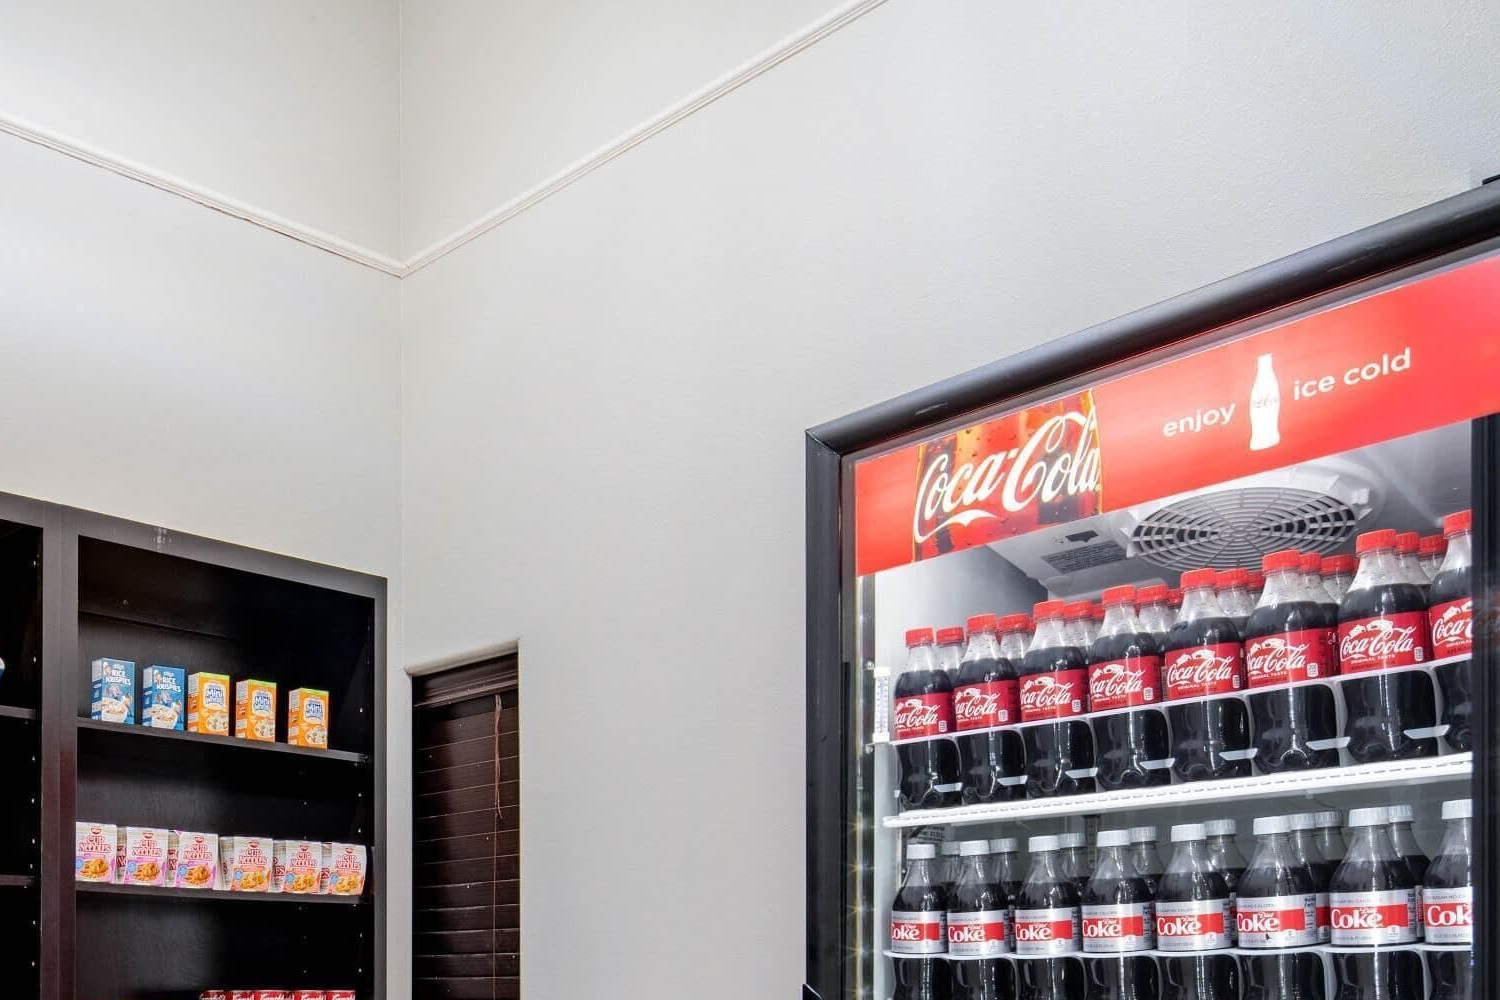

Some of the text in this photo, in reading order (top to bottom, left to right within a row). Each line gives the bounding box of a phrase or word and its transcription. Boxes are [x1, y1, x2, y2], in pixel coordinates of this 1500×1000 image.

[1293, 374, 1335, 402] ice
[1344, 347, 1412, 387] cold
[1161, 400, 1237, 440] enjoy
[913, 410, 1100, 544] Coca-Cola
[1340, 626, 1417, 662] Coca-Cola
[1167, 655, 1235, 688] Coca-Cola
[1082, 919, 1121, 937] Coke
[1157, 917, 1202, 937] Coke
[1236, 912, 1280, 932] Coke
[1331, 908, 1383, 929] Coke
[949, 926, 986, 942] Coke
[1016, 924, 1051, 940] Coke
